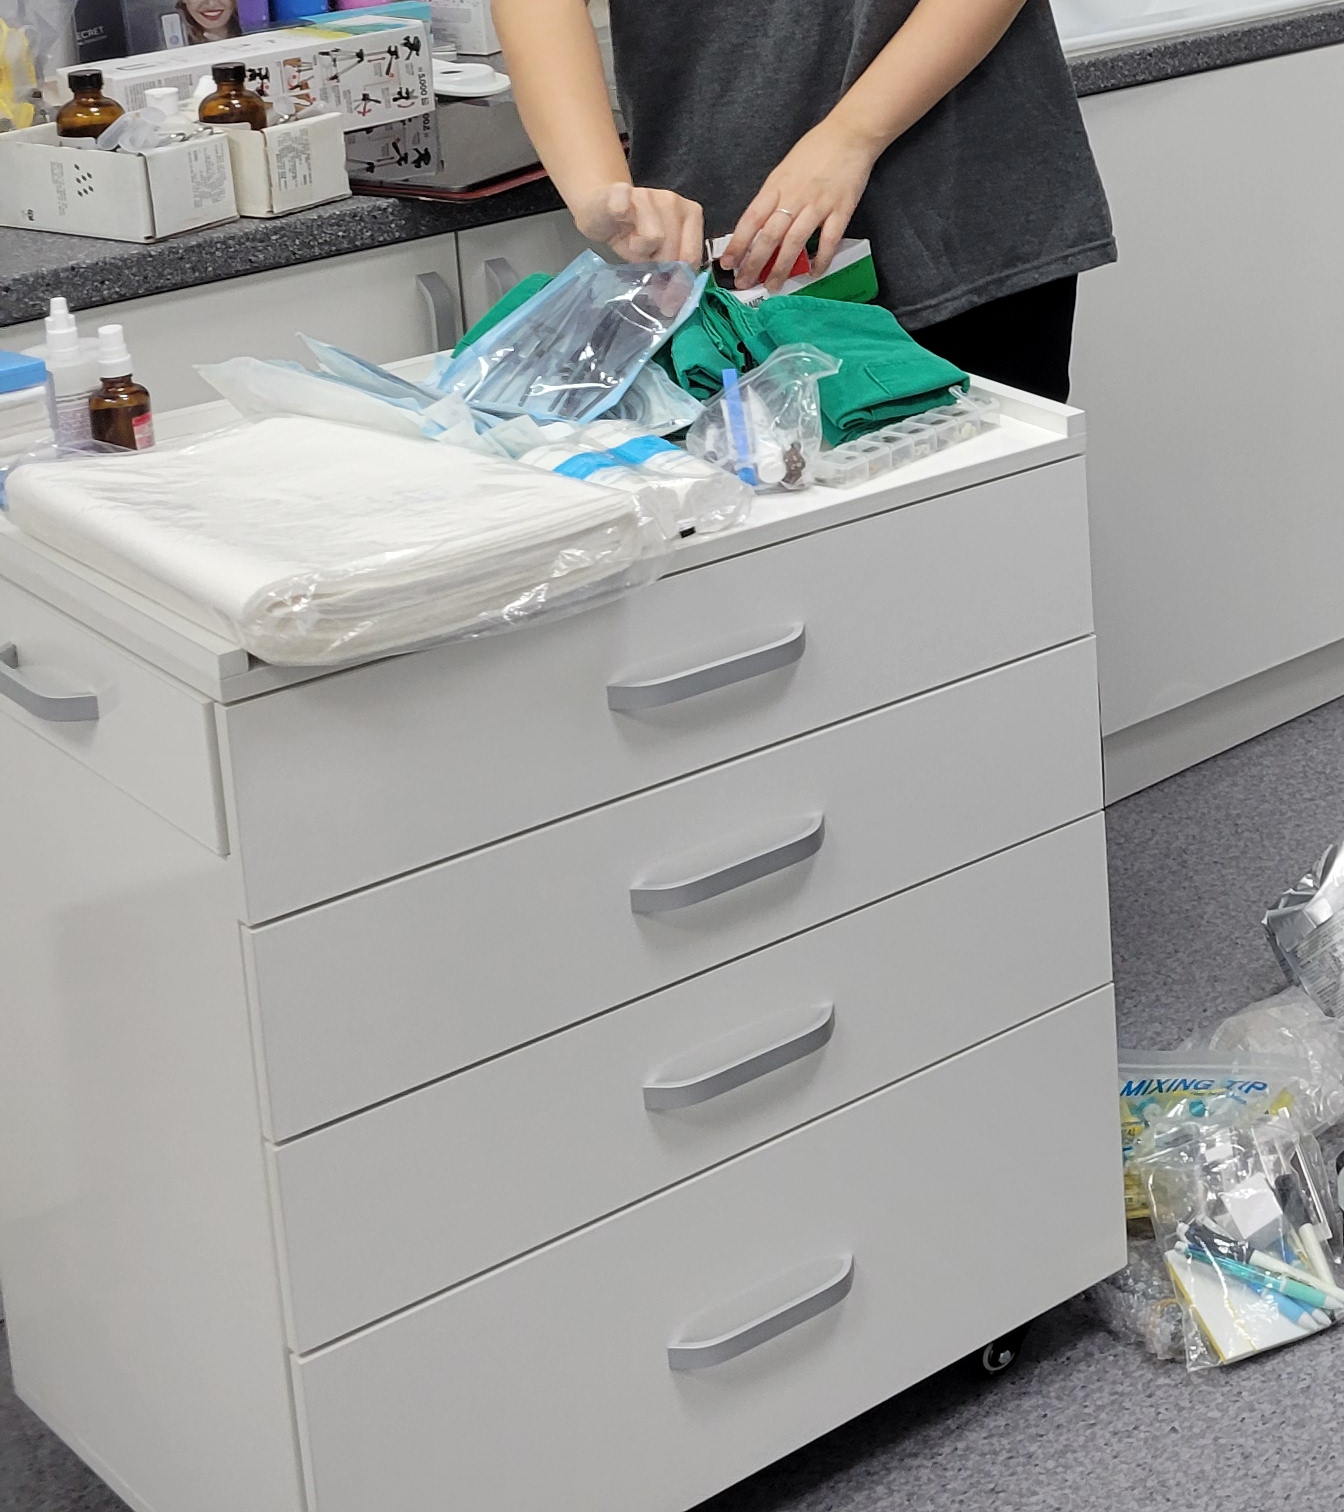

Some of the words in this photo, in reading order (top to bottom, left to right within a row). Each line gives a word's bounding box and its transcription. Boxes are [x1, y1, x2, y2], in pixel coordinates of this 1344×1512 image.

[77, 26, 104, 41] ECRET
[1119, 1078, 1215, 1097] MIXING
[1226, 1080, 1268, 1094] TIP
